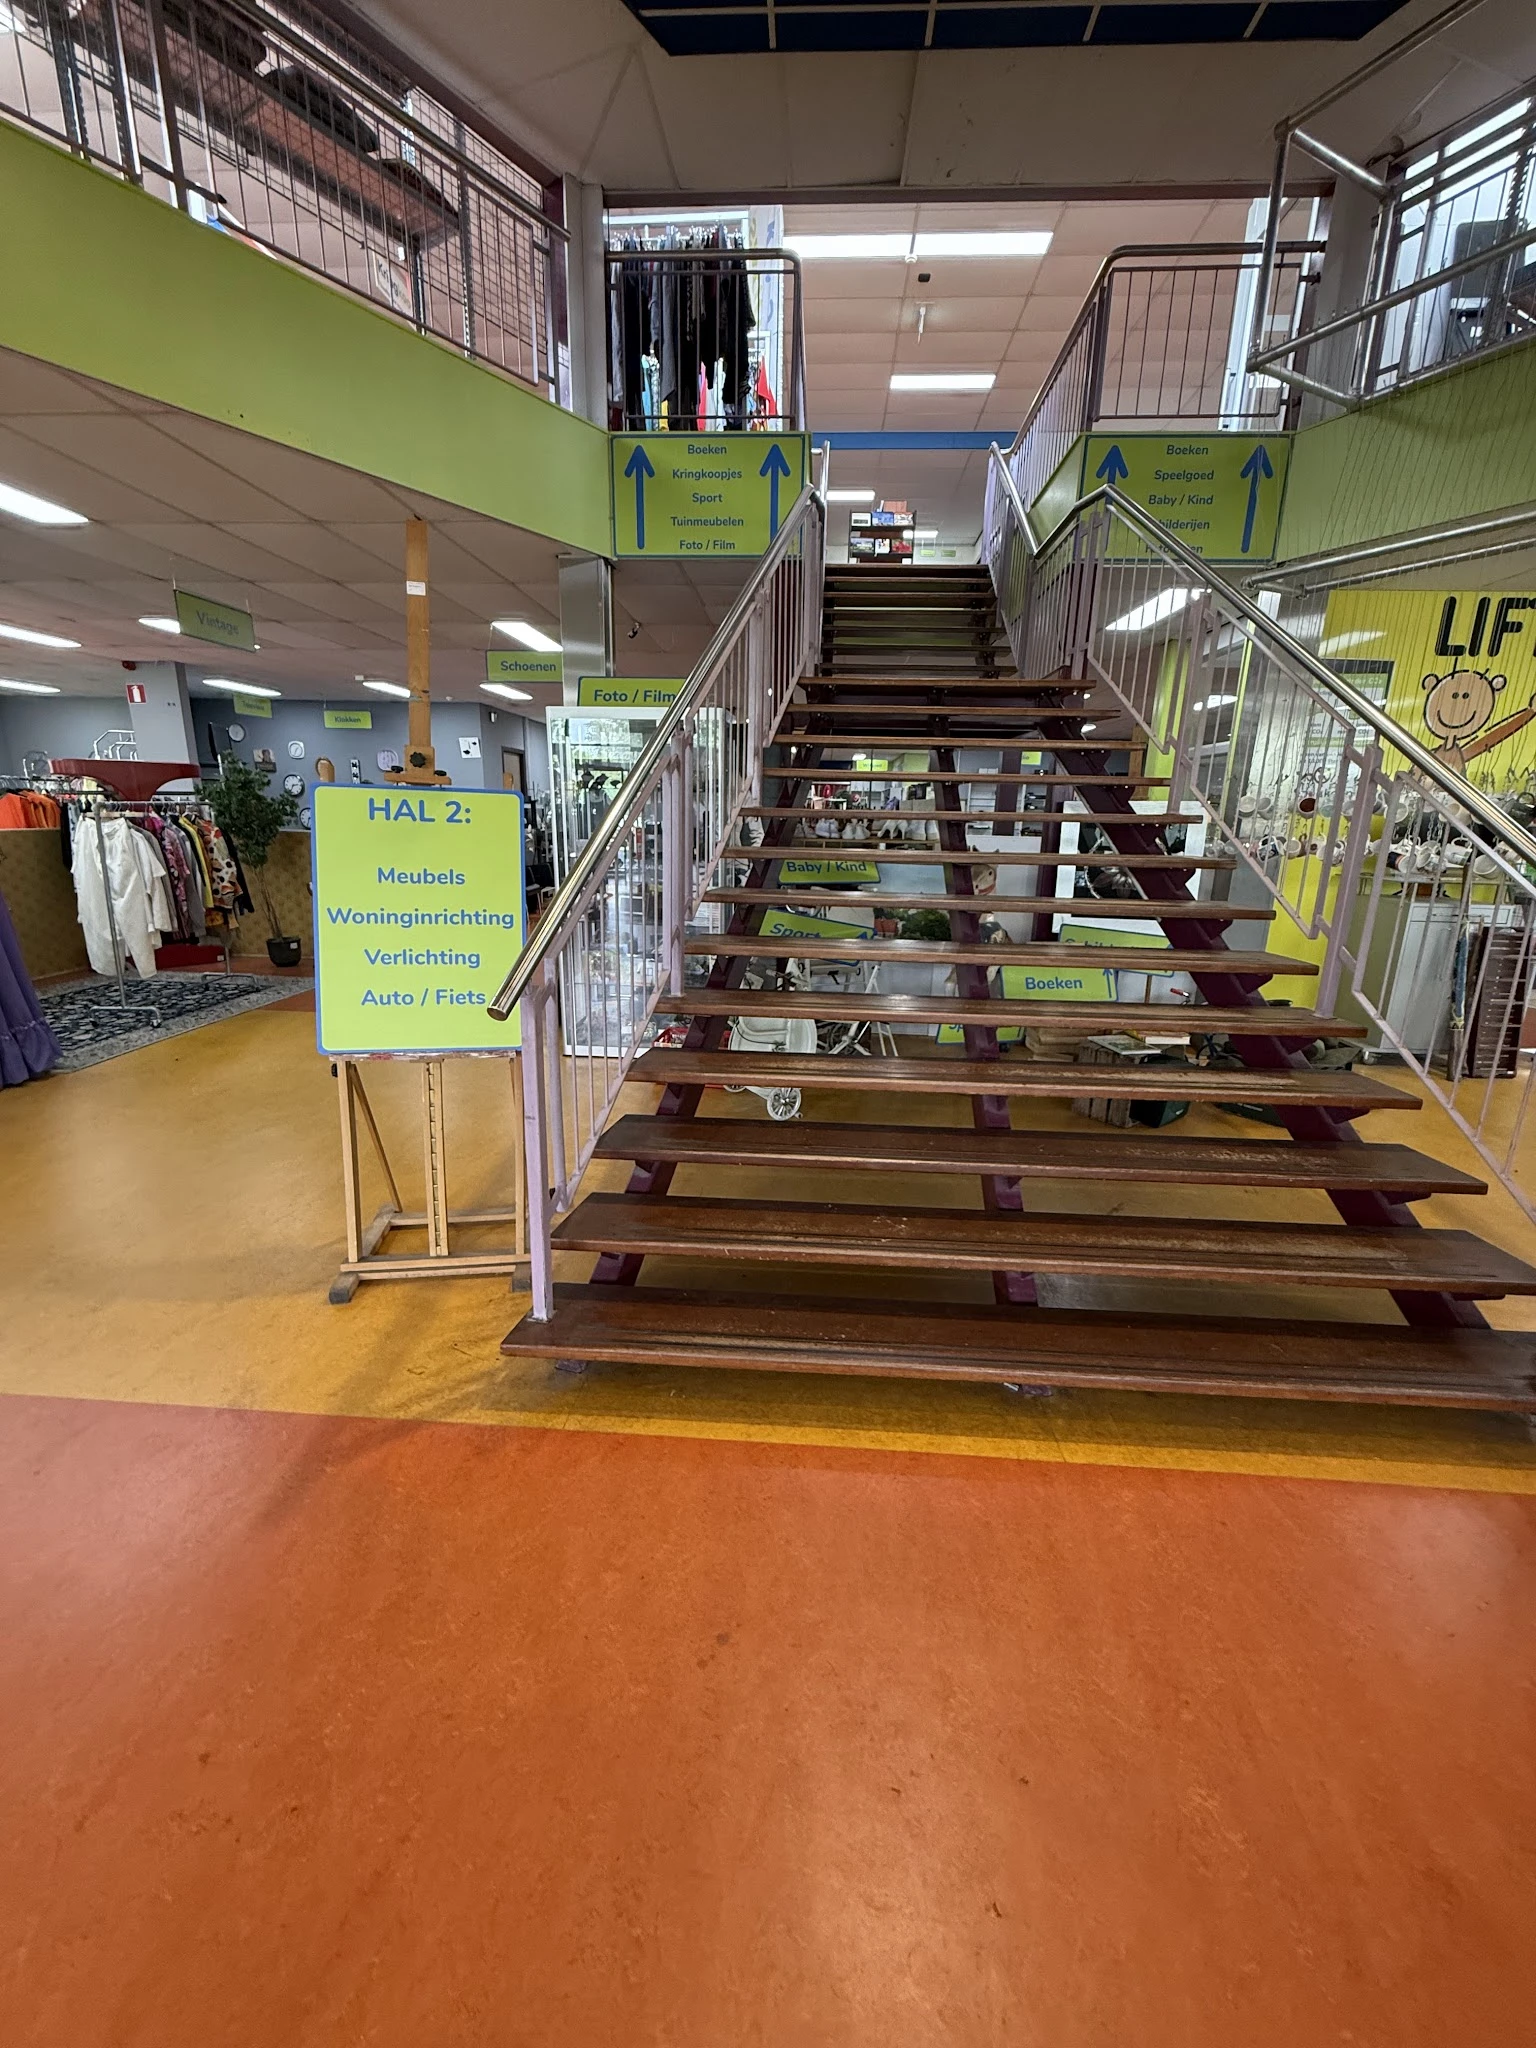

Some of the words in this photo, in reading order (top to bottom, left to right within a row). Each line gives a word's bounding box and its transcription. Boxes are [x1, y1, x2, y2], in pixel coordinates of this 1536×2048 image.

[687, 444, 727, 455] Boeken
[1166, 444, 1209, 455] Boeken
[672, 468, 742, 481] Kringkoopjes
[1154, 469, 1215, 482] Speelgoed
[692, 492, 723, 504] Sport
[1148, 494, 1177, 507] Baby
[1187, 494, 1214, 505] Kind
[670, 516, 744, 527] Tuinmeubelen
[1160, 518, 1210, 532] hilderijen
[679, 540, 703, 550] Foto
[713, 540, 736, 550] Film
[195, 609, 240, 636] Vintage
[1434, 596, 1536, 658] LIF
[500, 660, 557, 673] Schoenen
[593, 689, 628, 703] Foto
[643, 689, 677, 703] Film
[368, 797, 436, 823] HAL
[445, 799, 472, 824] 2:
[786, 861, 822, 874] Baby
[835, 861, 867, 872] Kind
[377, 867, 466, 885] Meubels
[326, 907, 515, 930] Woninginrichting
[364, 948, 481, 969] Verlichting
[1025, 976, 1083, 990] Boeken
[361, 988, 415, 1006] Auto
[435, 988, 487, 1005] Fiets
